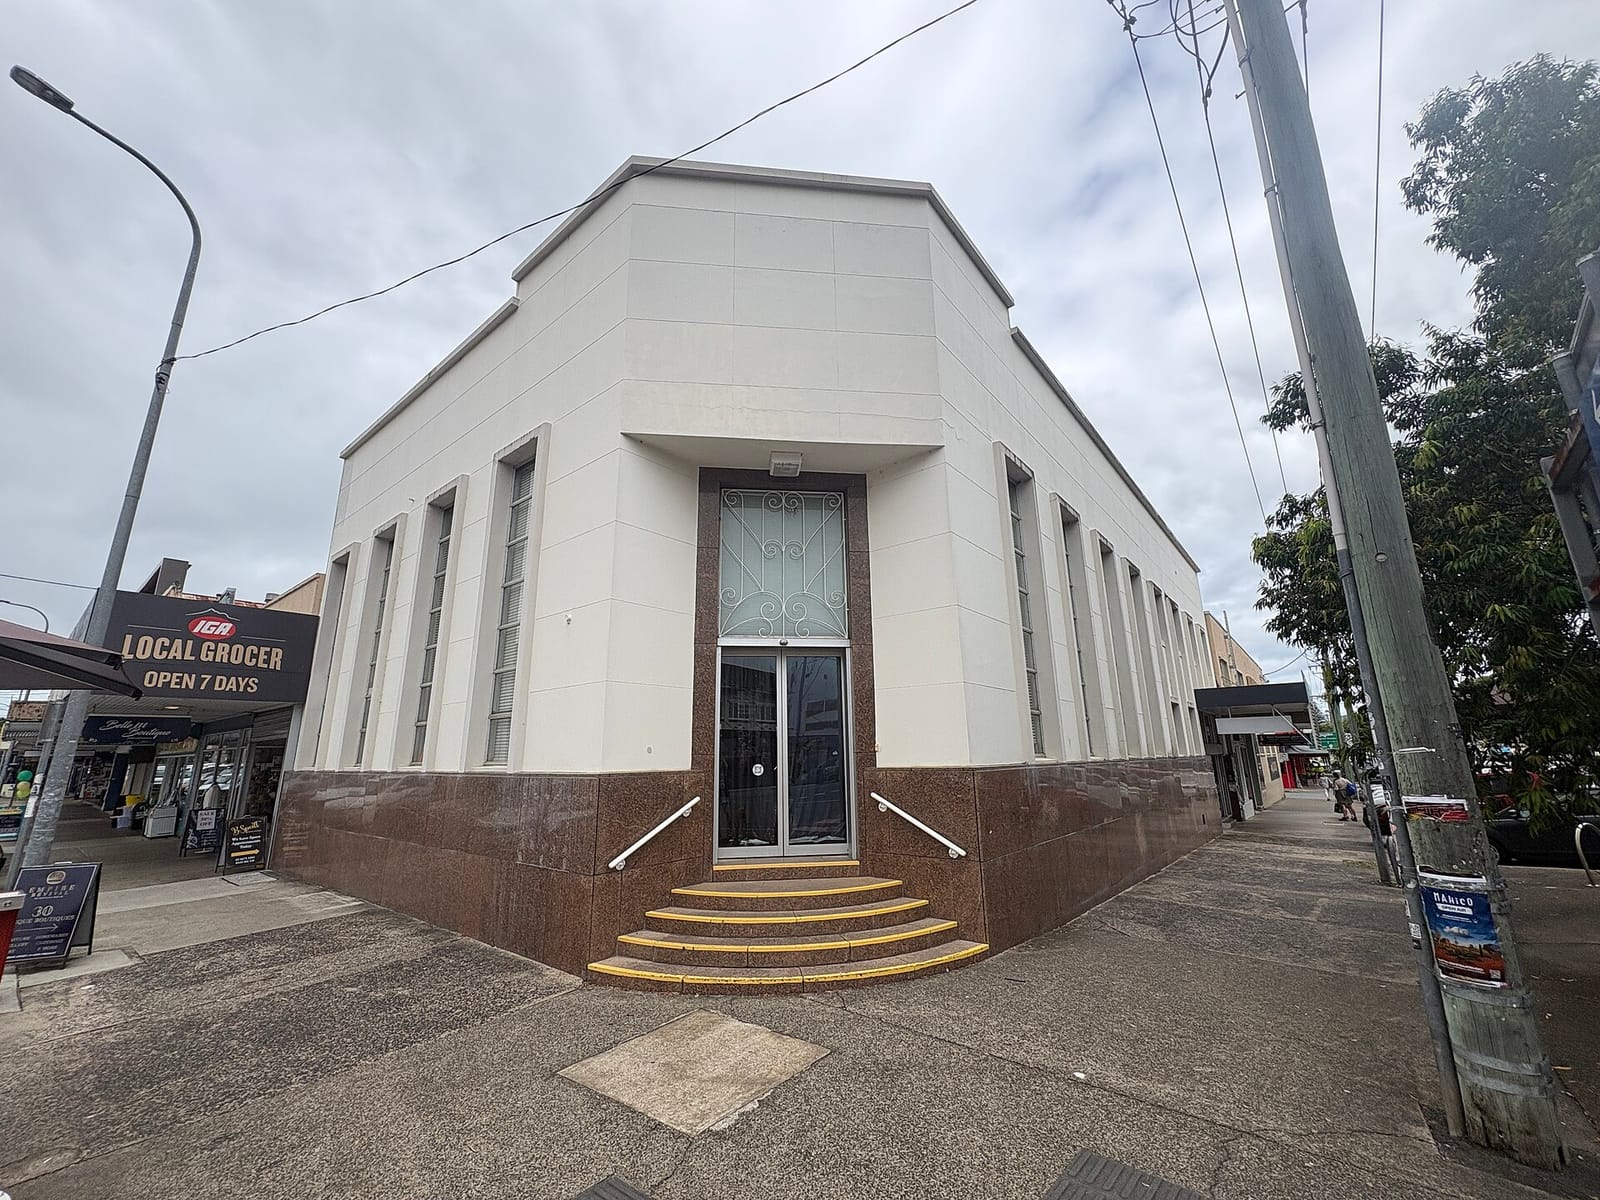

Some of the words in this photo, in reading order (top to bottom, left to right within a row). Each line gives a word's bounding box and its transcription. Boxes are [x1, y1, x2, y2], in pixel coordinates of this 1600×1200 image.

[193, 619, 233, 636] IGA
[121, 633, 196, 661] LOCAL
[200, 641, 284, 671] GROCER
[143, 670, 196, 690] OPEN
[199, 674, 213, 690] 7
[213, 675, 260, 693] DAYS
[28, 884, 76, 894] EMPIRE
[31, 905, 54, 918] 30
[34, 915, 76, 923] BOUTIQUES
